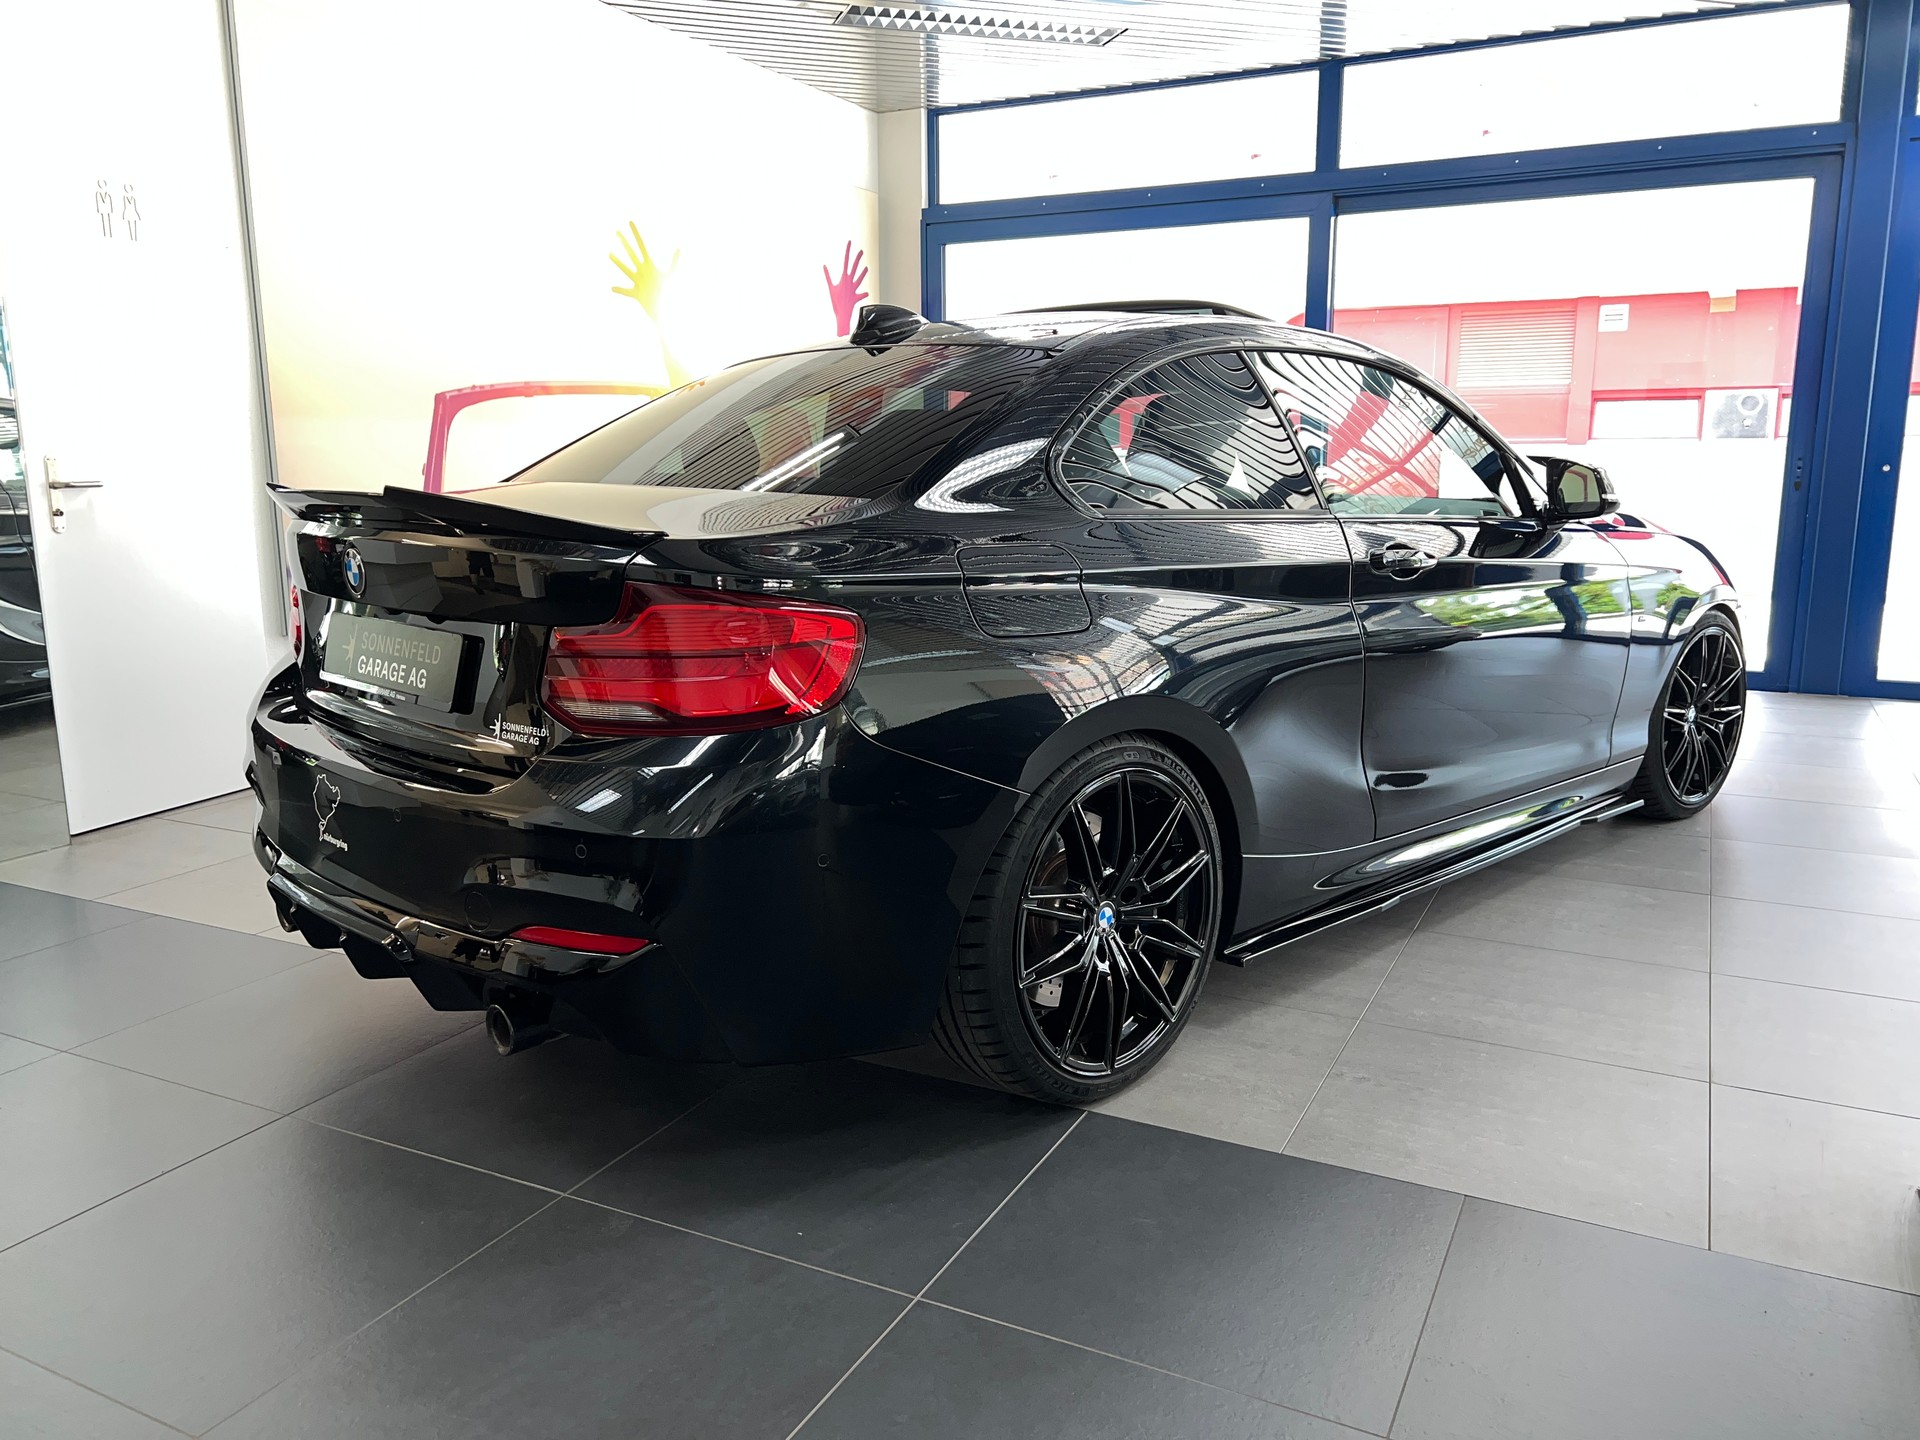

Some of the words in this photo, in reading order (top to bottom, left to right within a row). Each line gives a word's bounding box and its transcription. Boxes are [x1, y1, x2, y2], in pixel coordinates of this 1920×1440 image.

[361, 631, 441, 665] SONNENFELD
[357, 655, 407, 684] GARAGE
[407, 666, 427, 689] AG
[501, 731, 528, 744] GARAGE
[528, 736, 540, 746] AG
[502, 721, 547, 737] SONNENFELD
